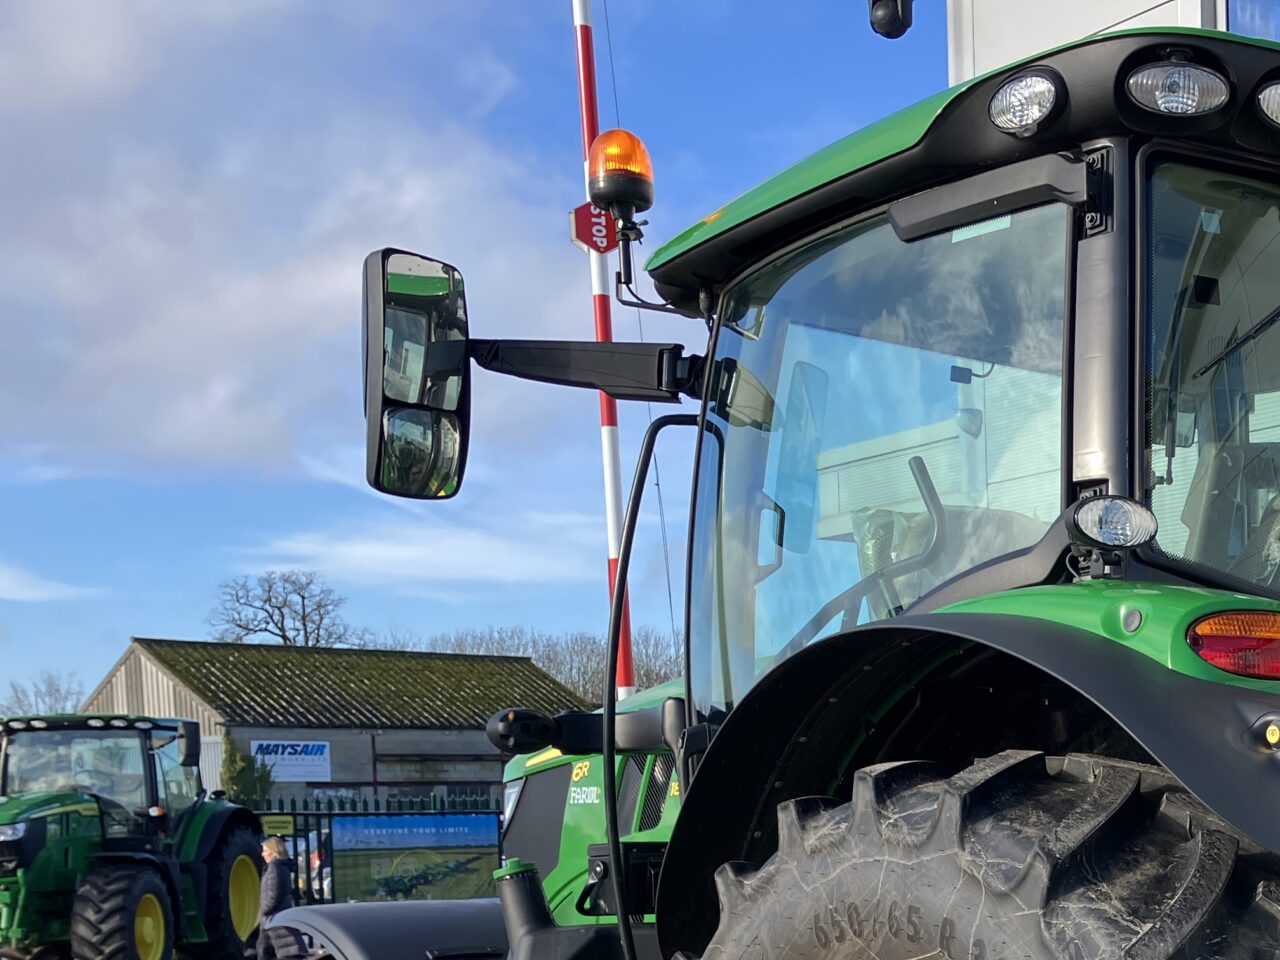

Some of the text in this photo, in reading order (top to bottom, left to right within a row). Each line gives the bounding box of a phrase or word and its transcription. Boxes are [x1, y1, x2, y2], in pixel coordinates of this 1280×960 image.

[255, 743, 327, 756] MAYSAIR
[571, 761, 590, 782] 6R
[569, 786, 600, 804] FAROL
